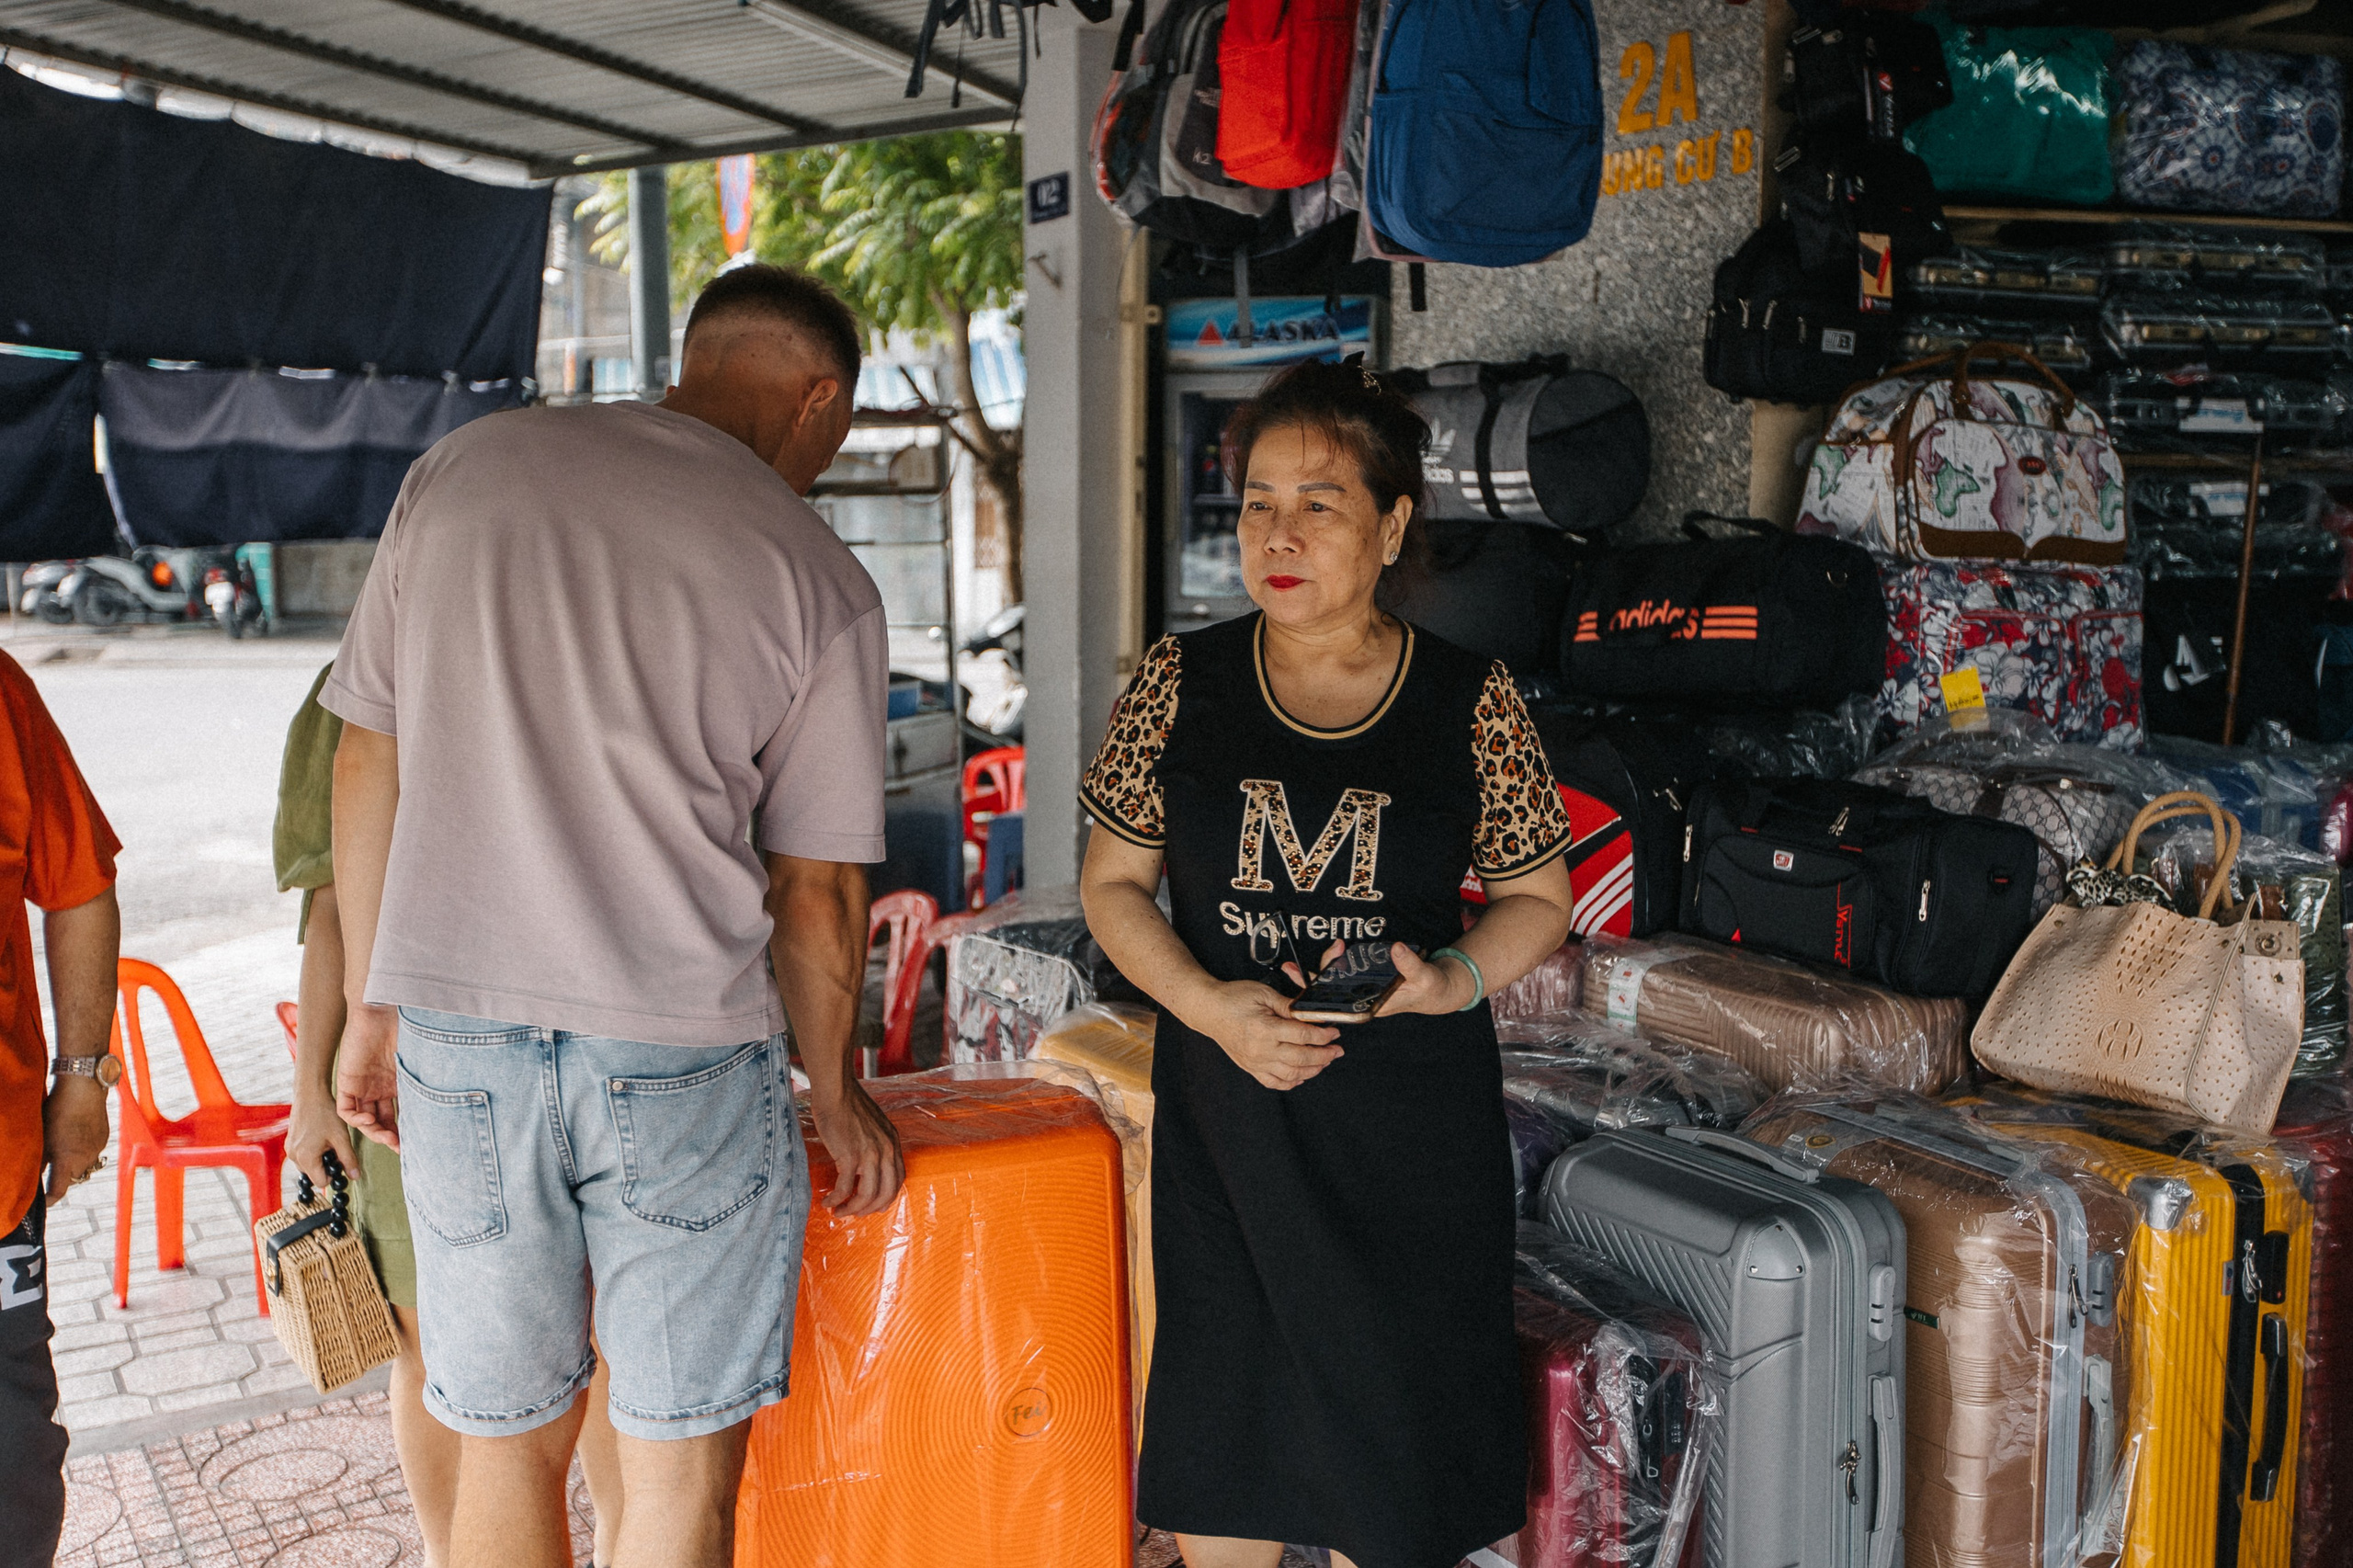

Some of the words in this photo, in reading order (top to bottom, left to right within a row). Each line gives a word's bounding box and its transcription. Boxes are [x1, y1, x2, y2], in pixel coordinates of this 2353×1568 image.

[1616, 30, 1698, 135] 2A
[1598, 144, 1664, 197] UNG
[1732, 128, 1754, 175] B
[1231, 779, 1392, 902] M
